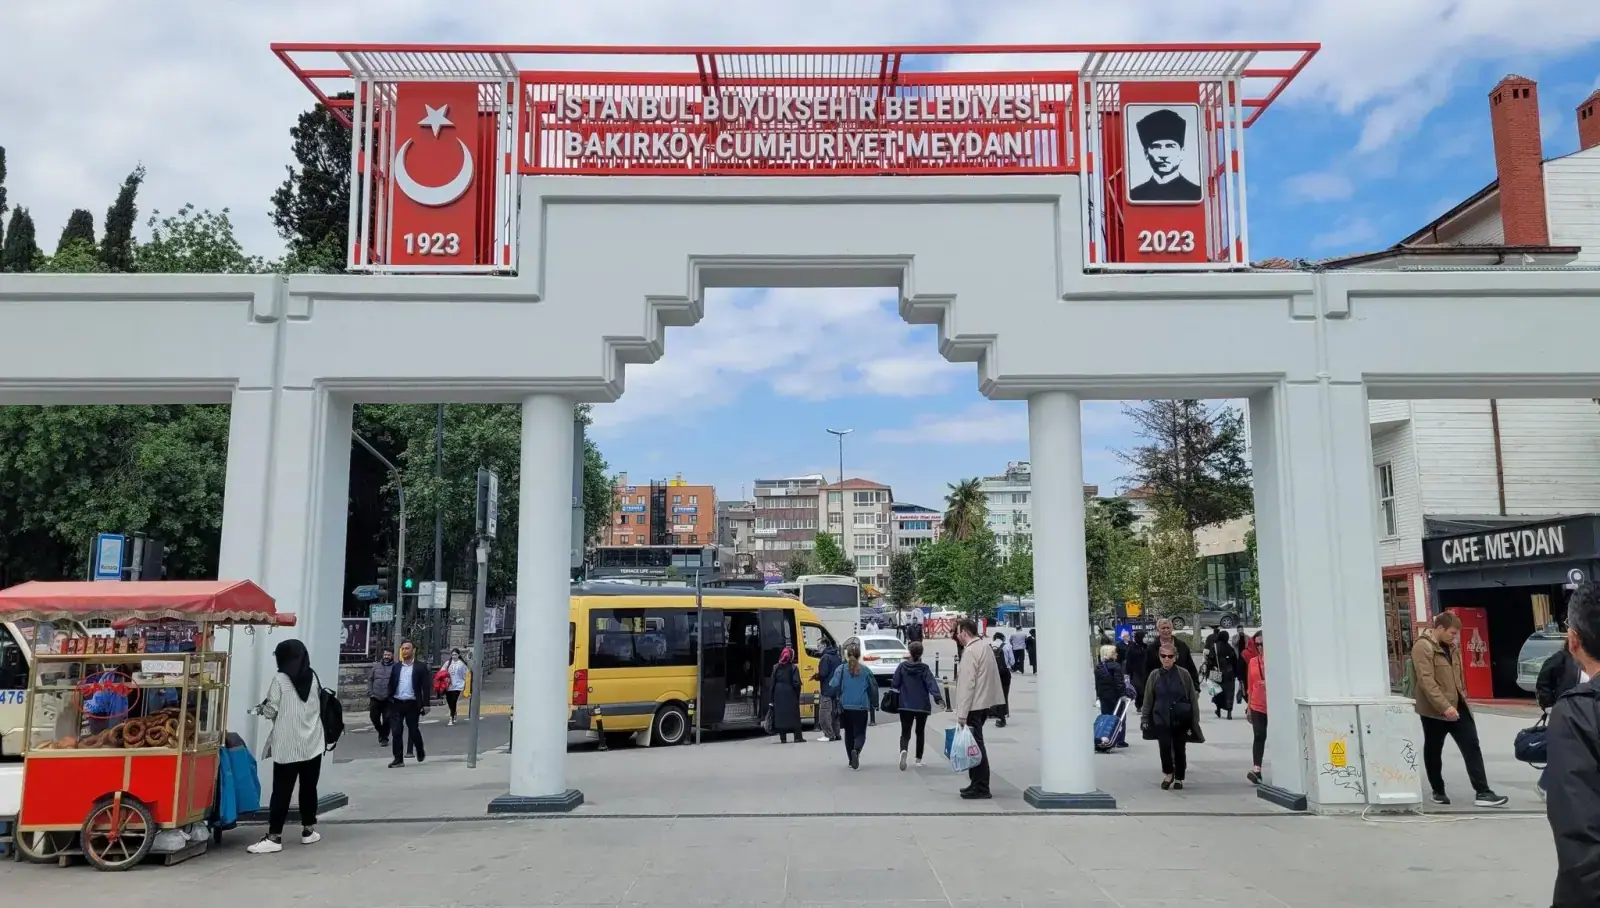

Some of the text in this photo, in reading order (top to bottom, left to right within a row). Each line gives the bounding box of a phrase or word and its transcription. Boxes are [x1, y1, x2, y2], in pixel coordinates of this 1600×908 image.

[557, 89, 1041, 123] İSTANBUL BÜYÜKŞEHİR BELEDİYESİ
[566, 127, 1033, 160] BAKIRKÖY CUMHURİYET MEYDANI
[403, 232, 460, 256] 1923
[1138, 230, 1195, 254] 2023
[1441, 525, 1565, 565] CAFE MEYDAN
